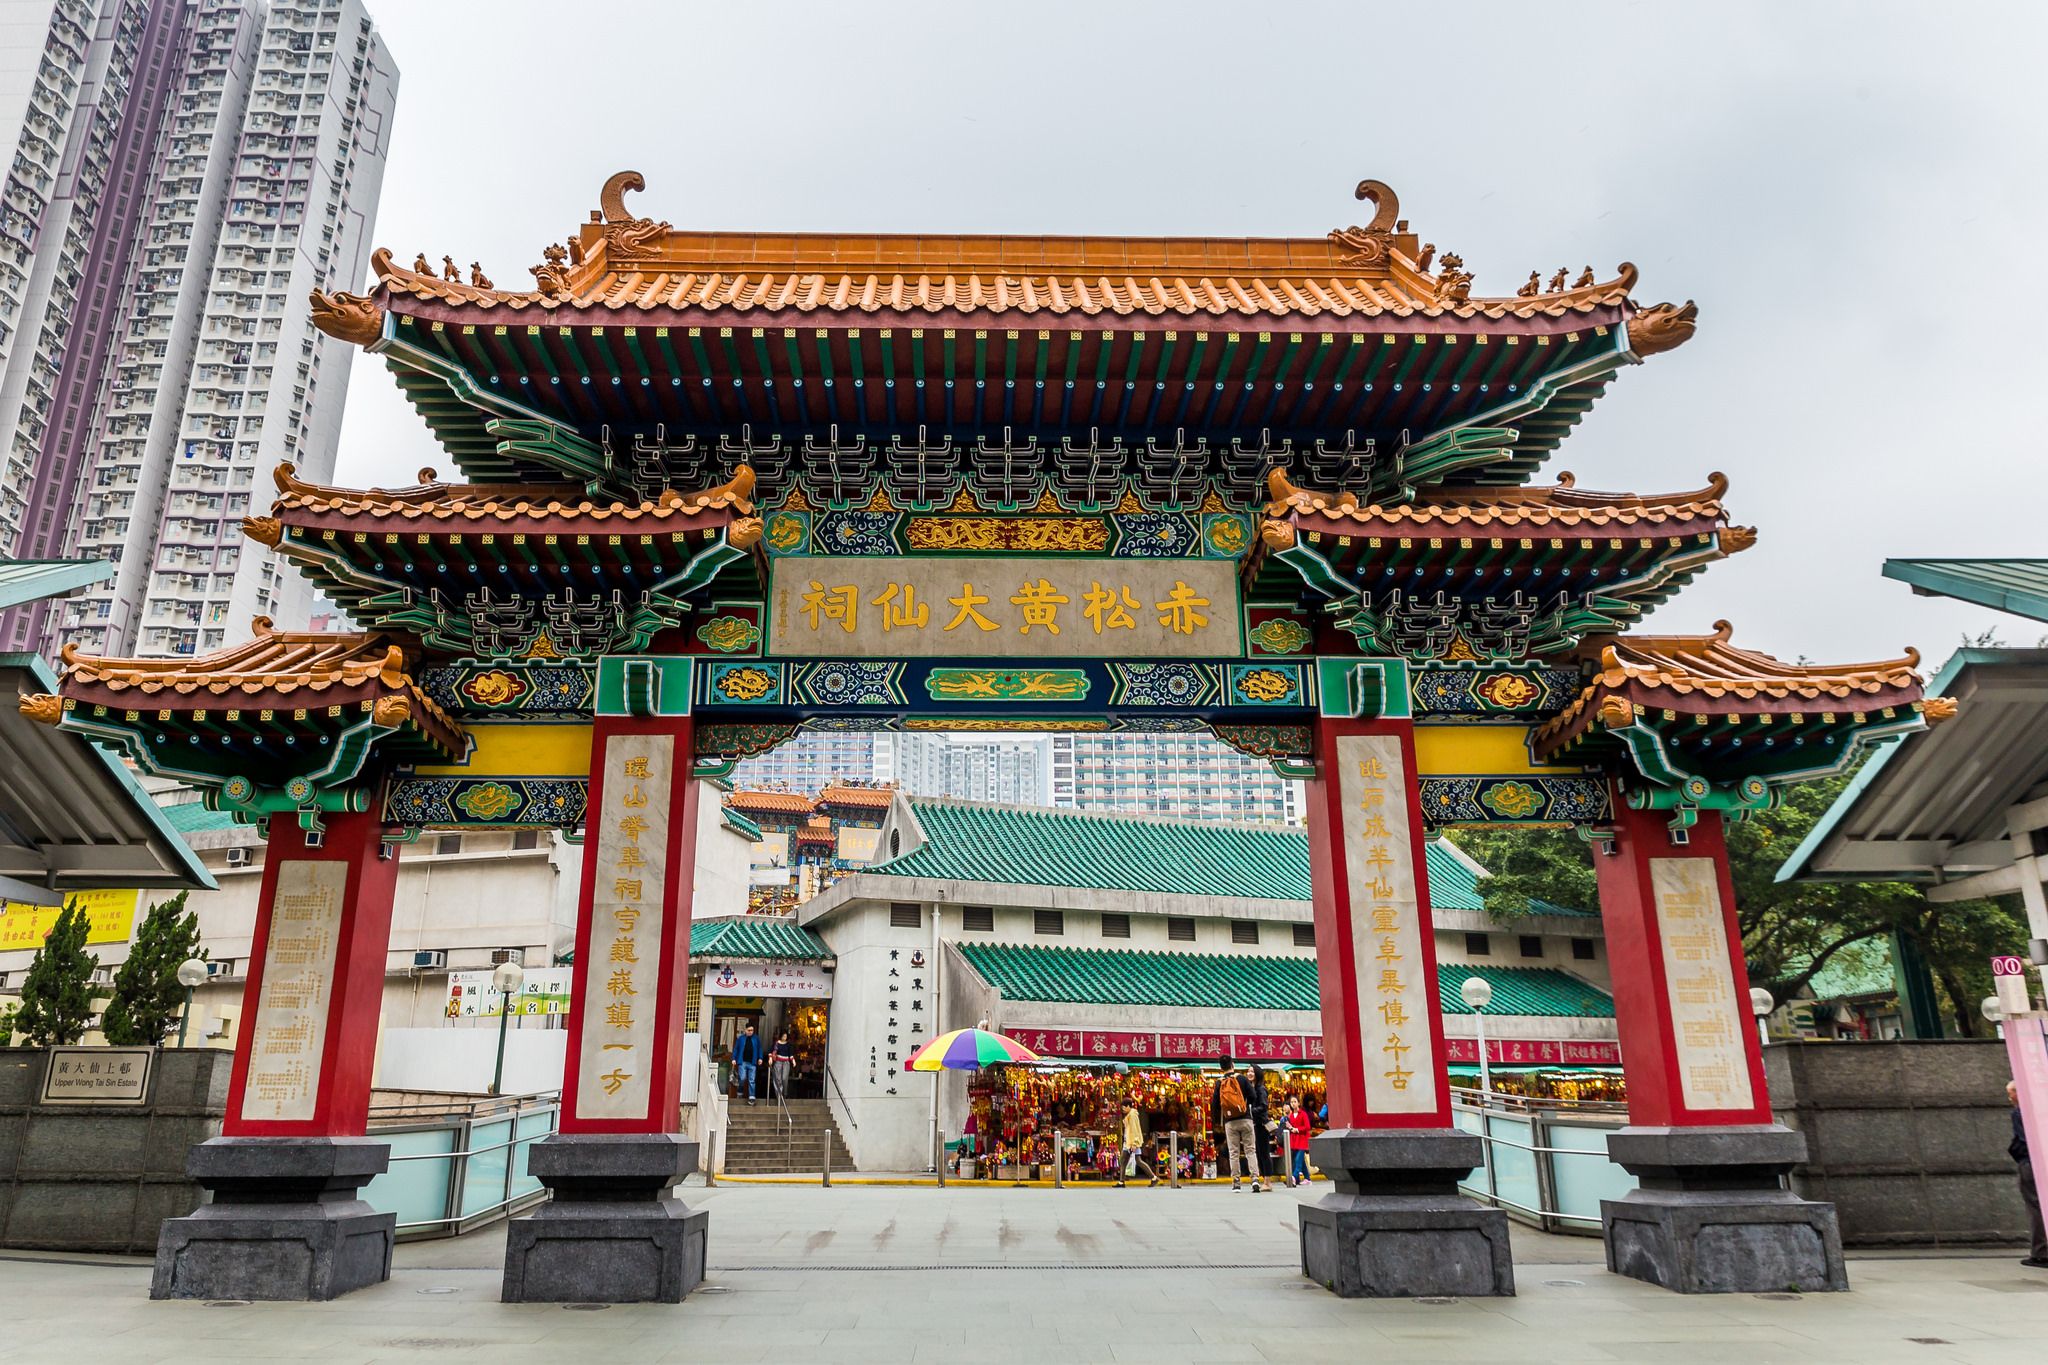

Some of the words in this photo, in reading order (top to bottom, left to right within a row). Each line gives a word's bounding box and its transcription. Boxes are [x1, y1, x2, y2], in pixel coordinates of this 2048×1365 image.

[54, 1078, 74, 1088] Upper
[75, 1078, 94, 1088] Wong
[95, 1078, 105, 1087] Tai
[105, 1078, 116, 1087] Sin
[117, 1079, 138, 1087] Estate
